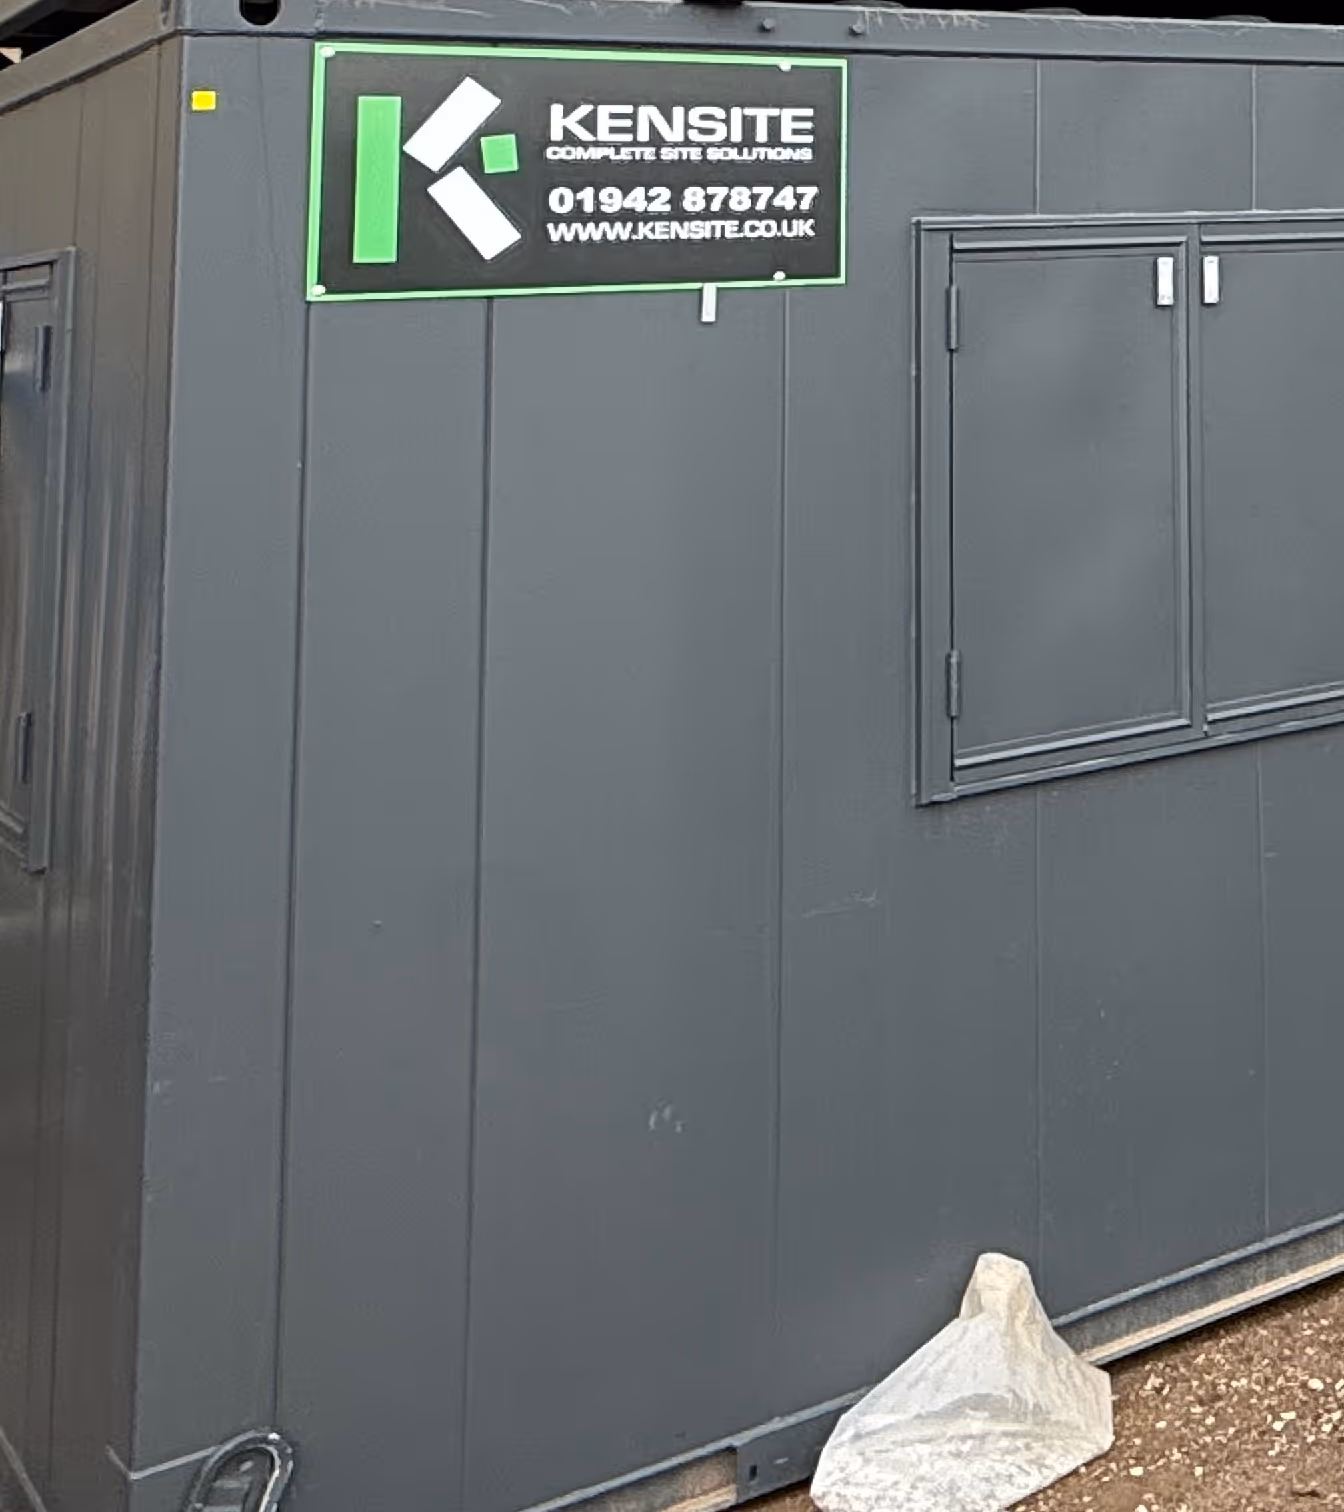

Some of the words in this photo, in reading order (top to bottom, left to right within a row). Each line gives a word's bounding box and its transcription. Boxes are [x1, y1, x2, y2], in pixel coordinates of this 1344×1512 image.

[549, 103, 814, 144] KENSITE
[546, 146, 657, 161] COMPLETE
[660, 146, 704, 161] SITE
[706, 146, 813, 161] SOLUTIONS
[548, 186, 672, 214] 01942
[681, 185, 818, 212] 878747
[547, 219, 815, 242] WWW.KENSITE.CO.UK
